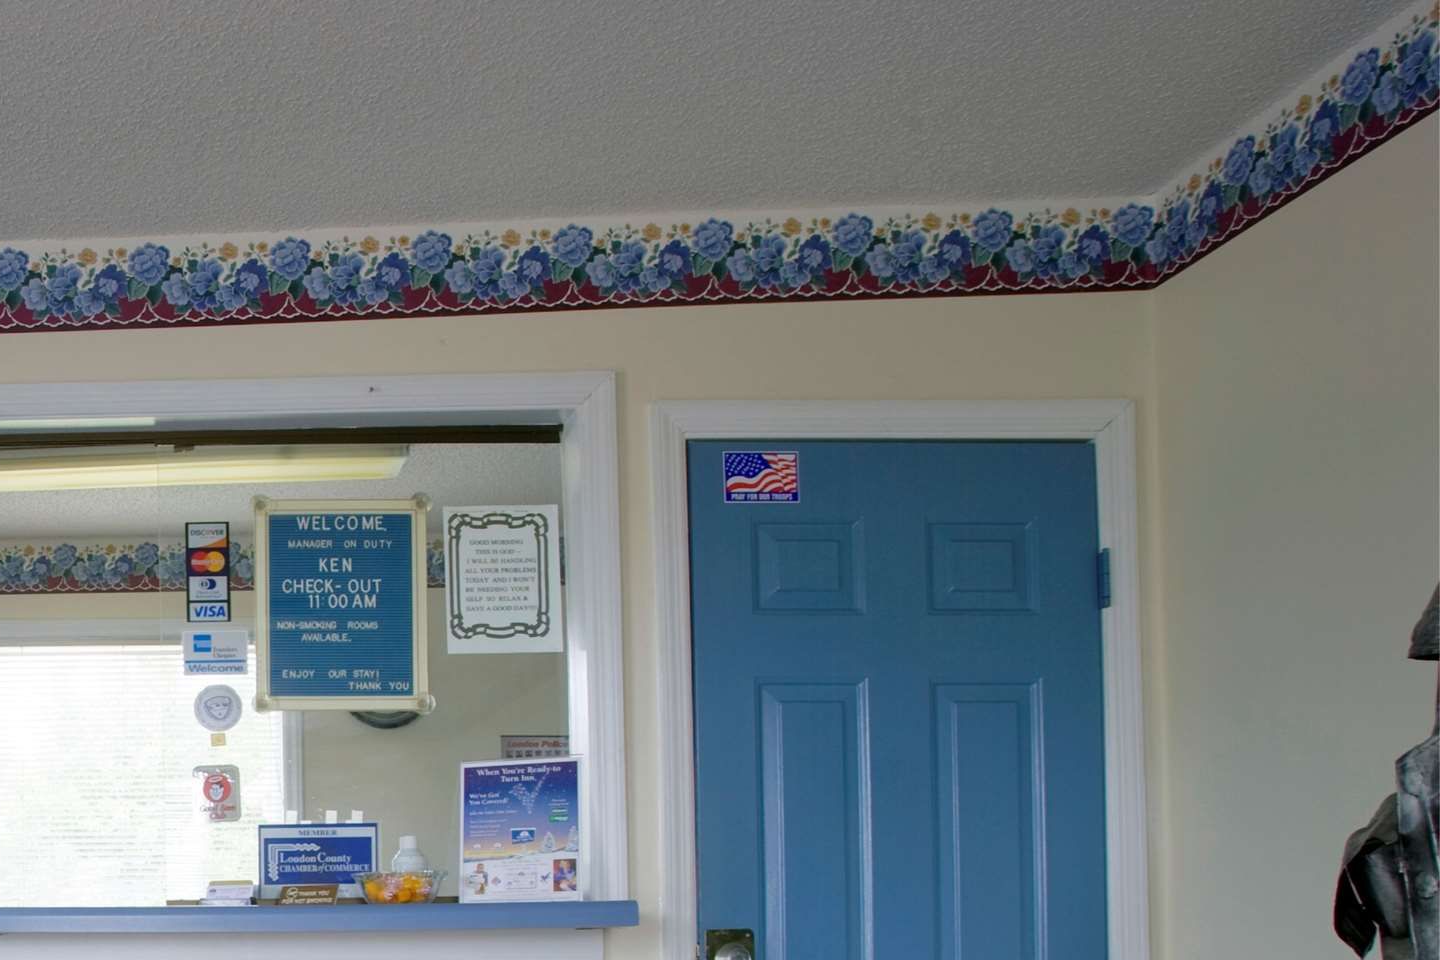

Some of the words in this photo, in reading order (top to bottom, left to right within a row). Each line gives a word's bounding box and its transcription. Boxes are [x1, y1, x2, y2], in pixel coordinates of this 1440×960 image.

[190, 528, 224, 536] DISCOVER
[287, 539, 333, 549] MANAGER
[344, 539, 357, 549] ON
[364, 539, 392, 549] DUTY
[318, 557, 353, 573] KEN
[348, 578, 382, 593] OUT
[308, 594, 348, 608] 11:00
[352, 593, 377, 608] AM
[194, 604, 227, 617] VISA
[276, 620, 337, 630] NON-SMOKING
[347, 620, 378, 630] ROOMS
[188, 663, 244, 673] Welcome
[282, 669, 315, 679] ENJOY
[328, 669, 347, 679] OUR
[348, 681, 382, 690] THANK
[389, 681, 410, 690] YOU
[476, 768, 500, 776] When
[502, 767, 526, 775] You're
[501, 775, 519, 783] Turn
[317, 852, 352, 864] County
[280, 864, 316, 873] CHAMBER
[325, 863, 369, 873] COMMERCE
